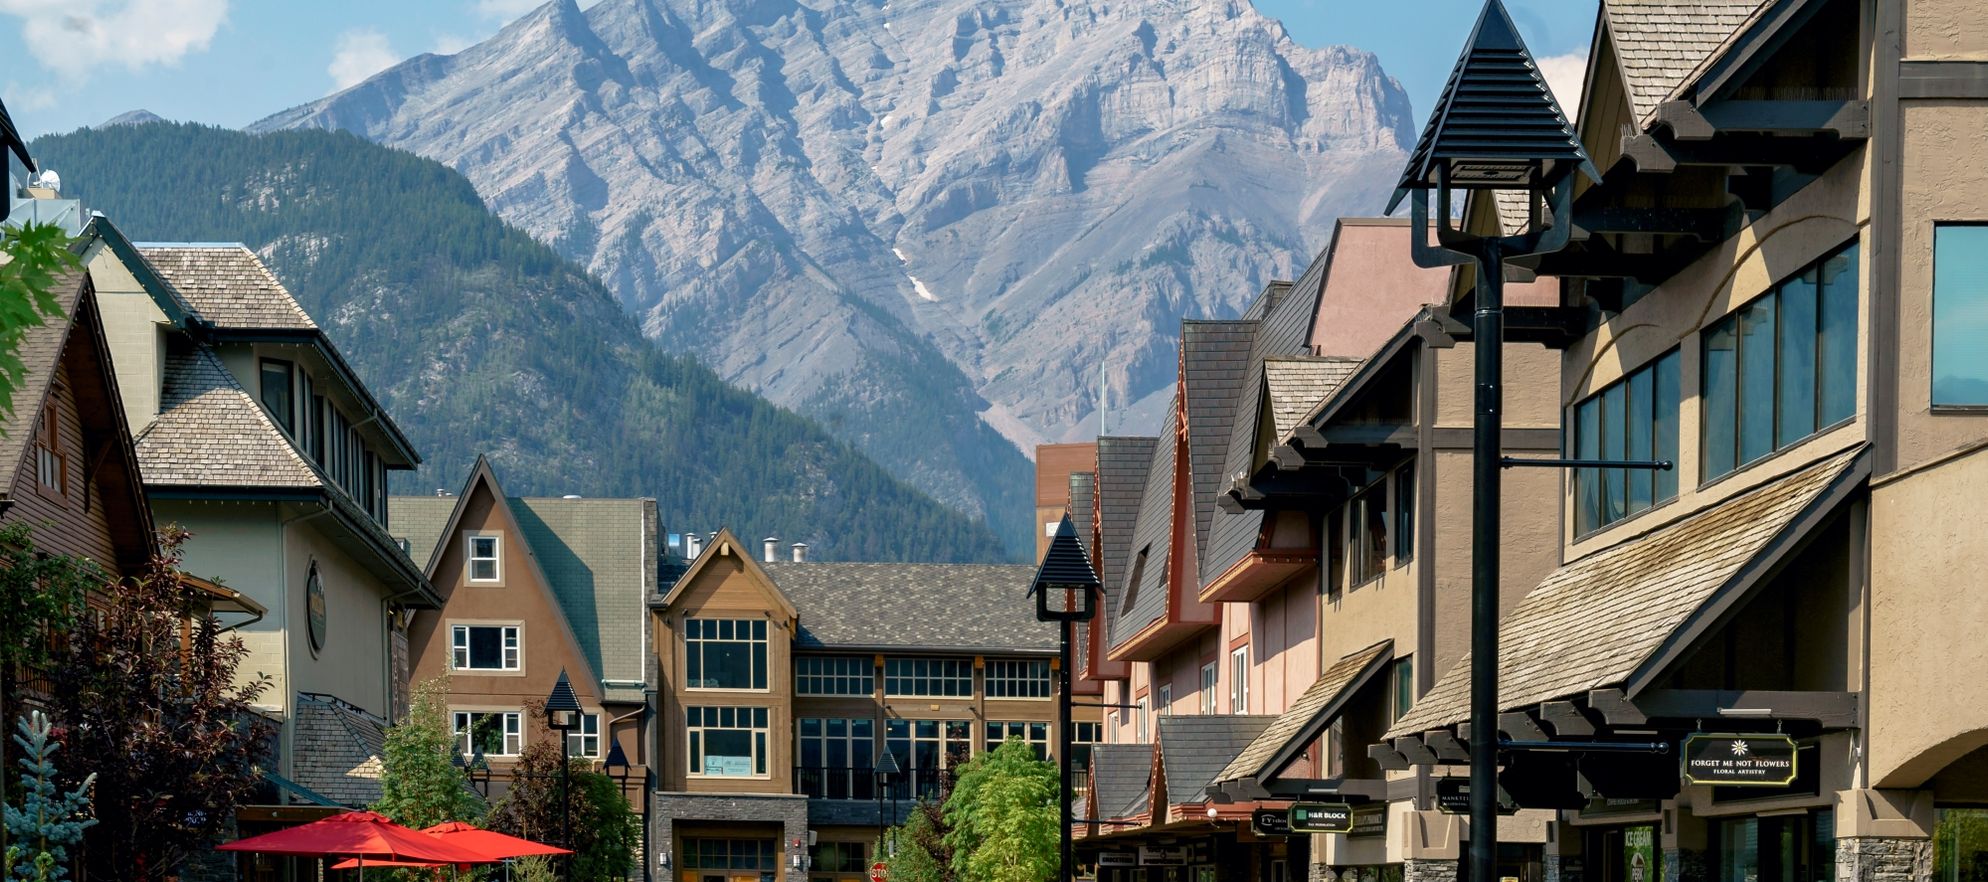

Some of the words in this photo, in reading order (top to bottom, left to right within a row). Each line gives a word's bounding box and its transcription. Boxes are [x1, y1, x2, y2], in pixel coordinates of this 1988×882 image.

[1625, 831, 1633, 847] ICE
[1634, 831, 1651, 847] CREAM
[872, 868, 887, 878] STO
